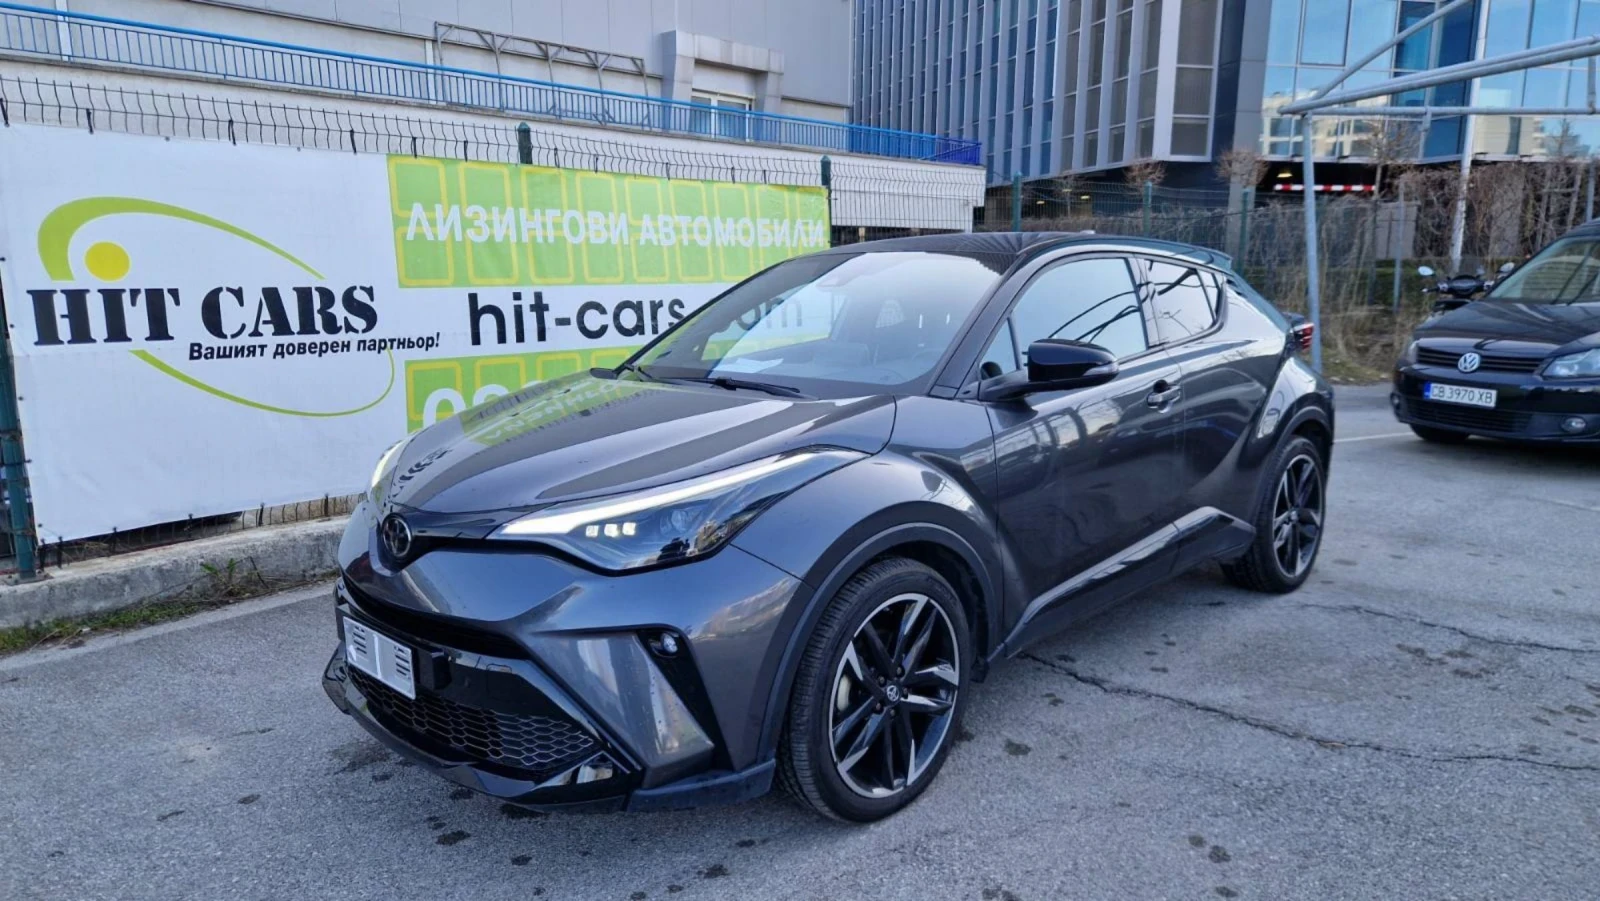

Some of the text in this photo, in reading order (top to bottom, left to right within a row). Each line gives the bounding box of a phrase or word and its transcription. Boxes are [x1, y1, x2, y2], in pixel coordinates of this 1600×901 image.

[406, 203, 824, 248] ЛИЗИНГОВИ АВТОМОБИЛИ
[26, 285, 379, 346] HIT CARS
[189, 332, 440, 360] Вашият доверен партньор!
[1447, 387, 1474, 402] 3970
[1477, 390, 1493, 404] XB
